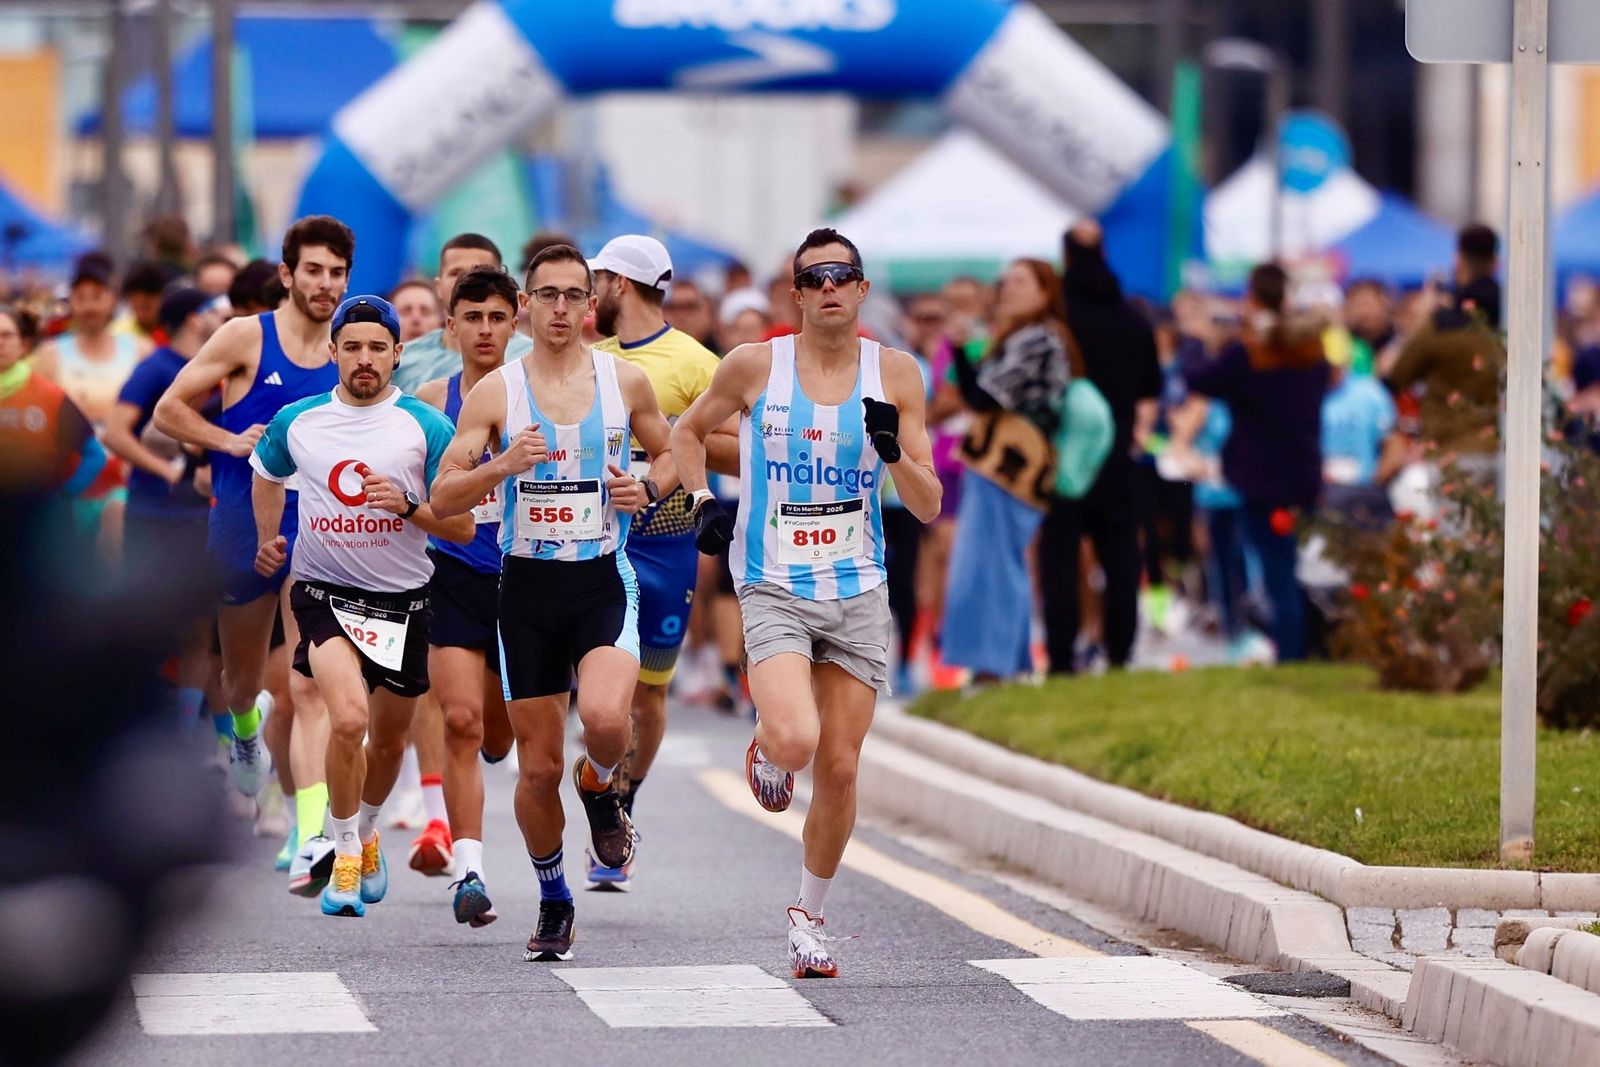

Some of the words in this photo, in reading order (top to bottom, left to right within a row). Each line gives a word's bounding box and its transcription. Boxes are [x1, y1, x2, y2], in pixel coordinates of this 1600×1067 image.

[766, 403, 790, 413] vive
[826, 504, 844, 513] 2026
[529, 506, 574, 523] 556
[310, 513, 404, 533] vodafone
[793, 528, 837, 546] 810
[322, 538, 369, 548] Innovation
[370, 538, 390, 548] Hub
[349, 604, 366, 612] March
